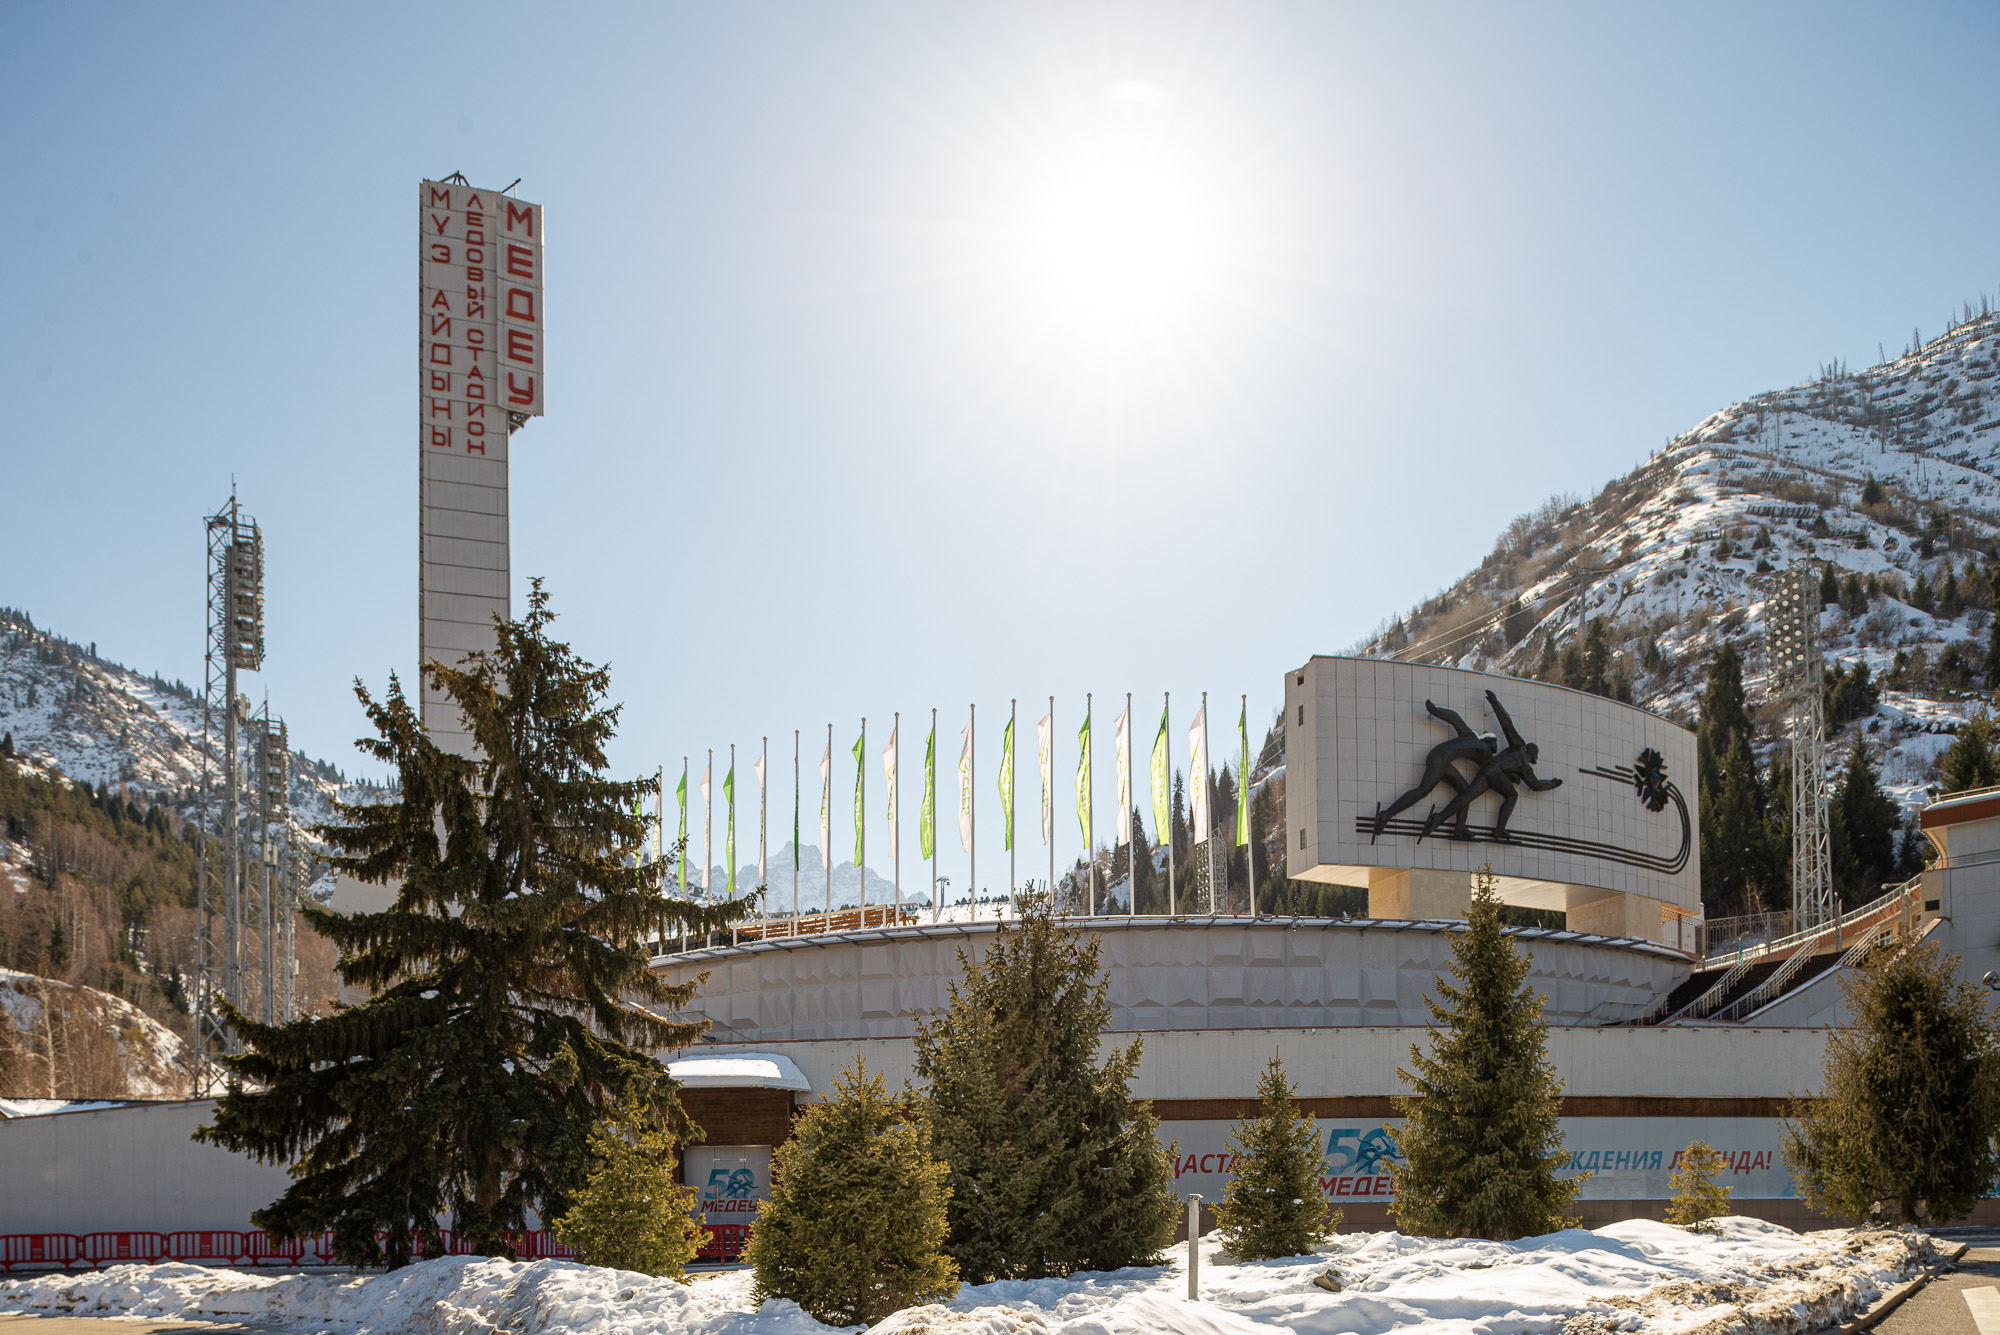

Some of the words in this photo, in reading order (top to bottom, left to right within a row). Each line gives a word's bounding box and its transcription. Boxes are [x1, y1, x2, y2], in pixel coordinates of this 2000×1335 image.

[466, 193, 485, 320] ЛЕДОВЫЙ
[506, 201, 535, 406] МЕДЕУ
[430, 289, 452, 448] АЙДЫНЫ
[466, 328, 485, 456] СТАДИОН
[701, 1200, 759, 1213] МЕДЕУ
[705, 1168, 755, 1199] 50
[1537, 1150, 1663, 1176] ЖДЕНИЯ
[1668, 1151, 1773, 1176] ЛНДА!
